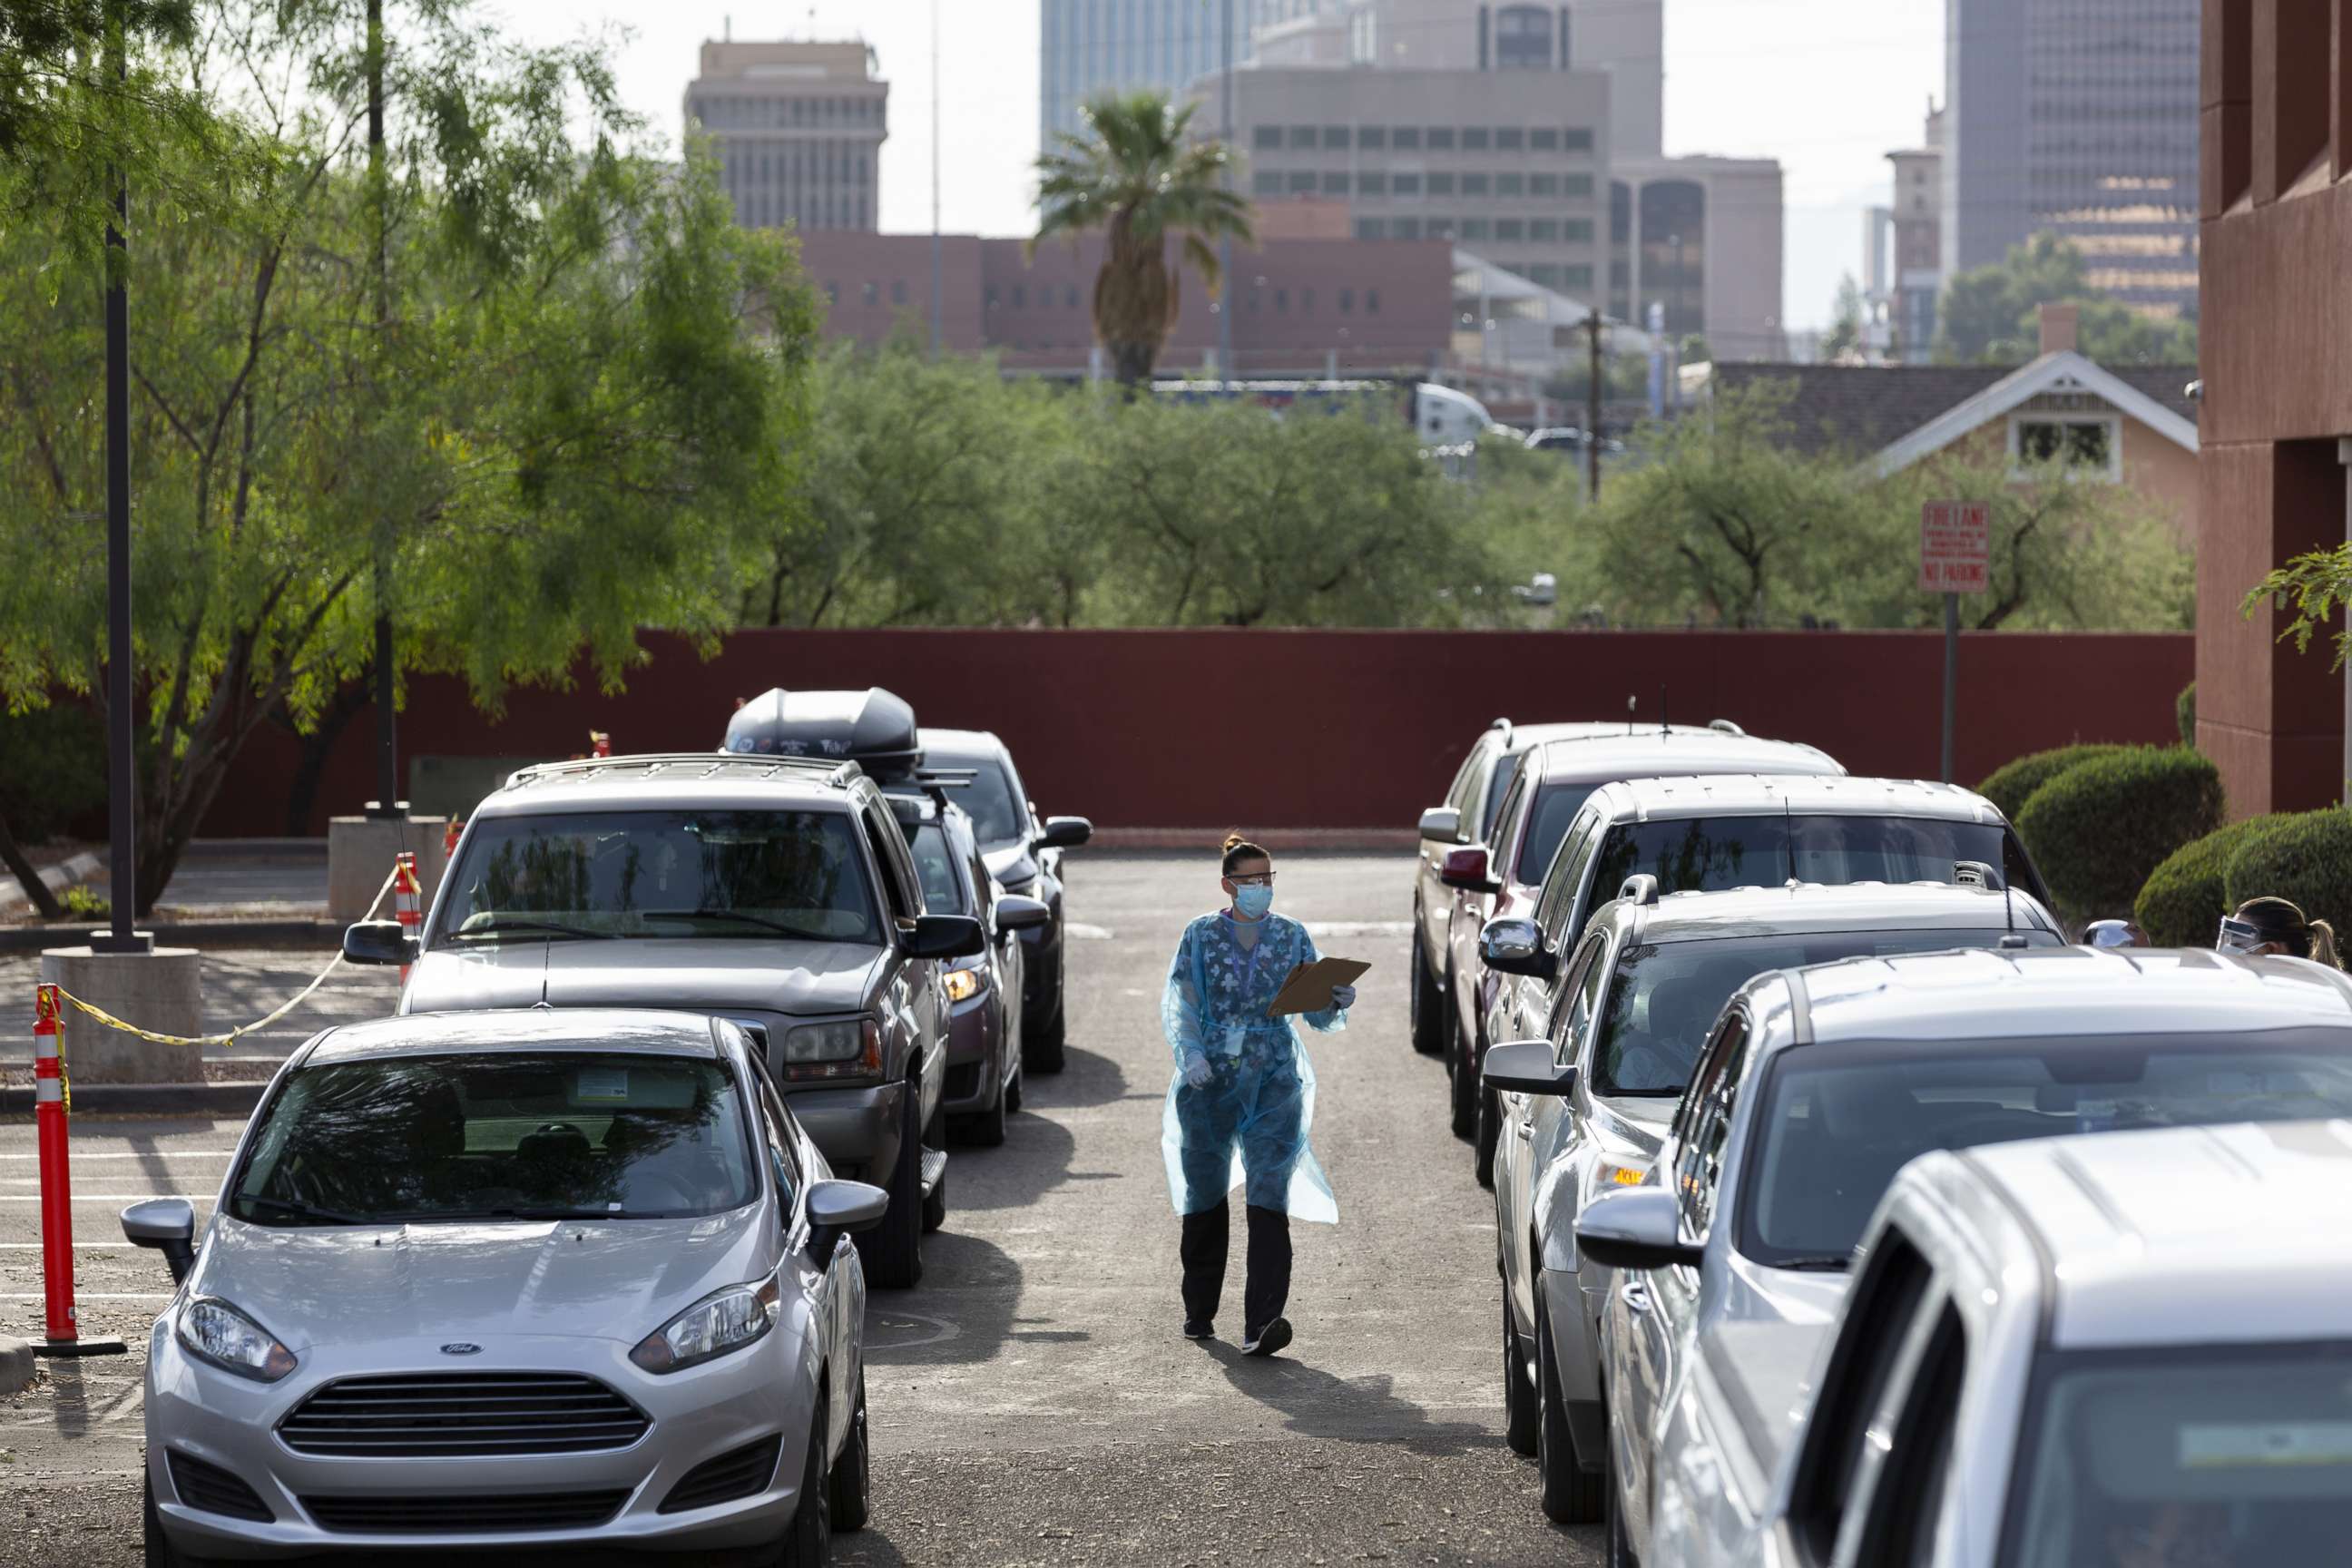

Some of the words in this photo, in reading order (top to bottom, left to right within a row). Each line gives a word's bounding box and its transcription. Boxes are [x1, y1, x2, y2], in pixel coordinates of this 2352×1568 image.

[1926, 507, 1949, 526] FIRE
[1953, 507, 1984, 526] LANE
[1925, 563, 1939, 582] NO
[1943, 563, 1984, 582] PARKING
